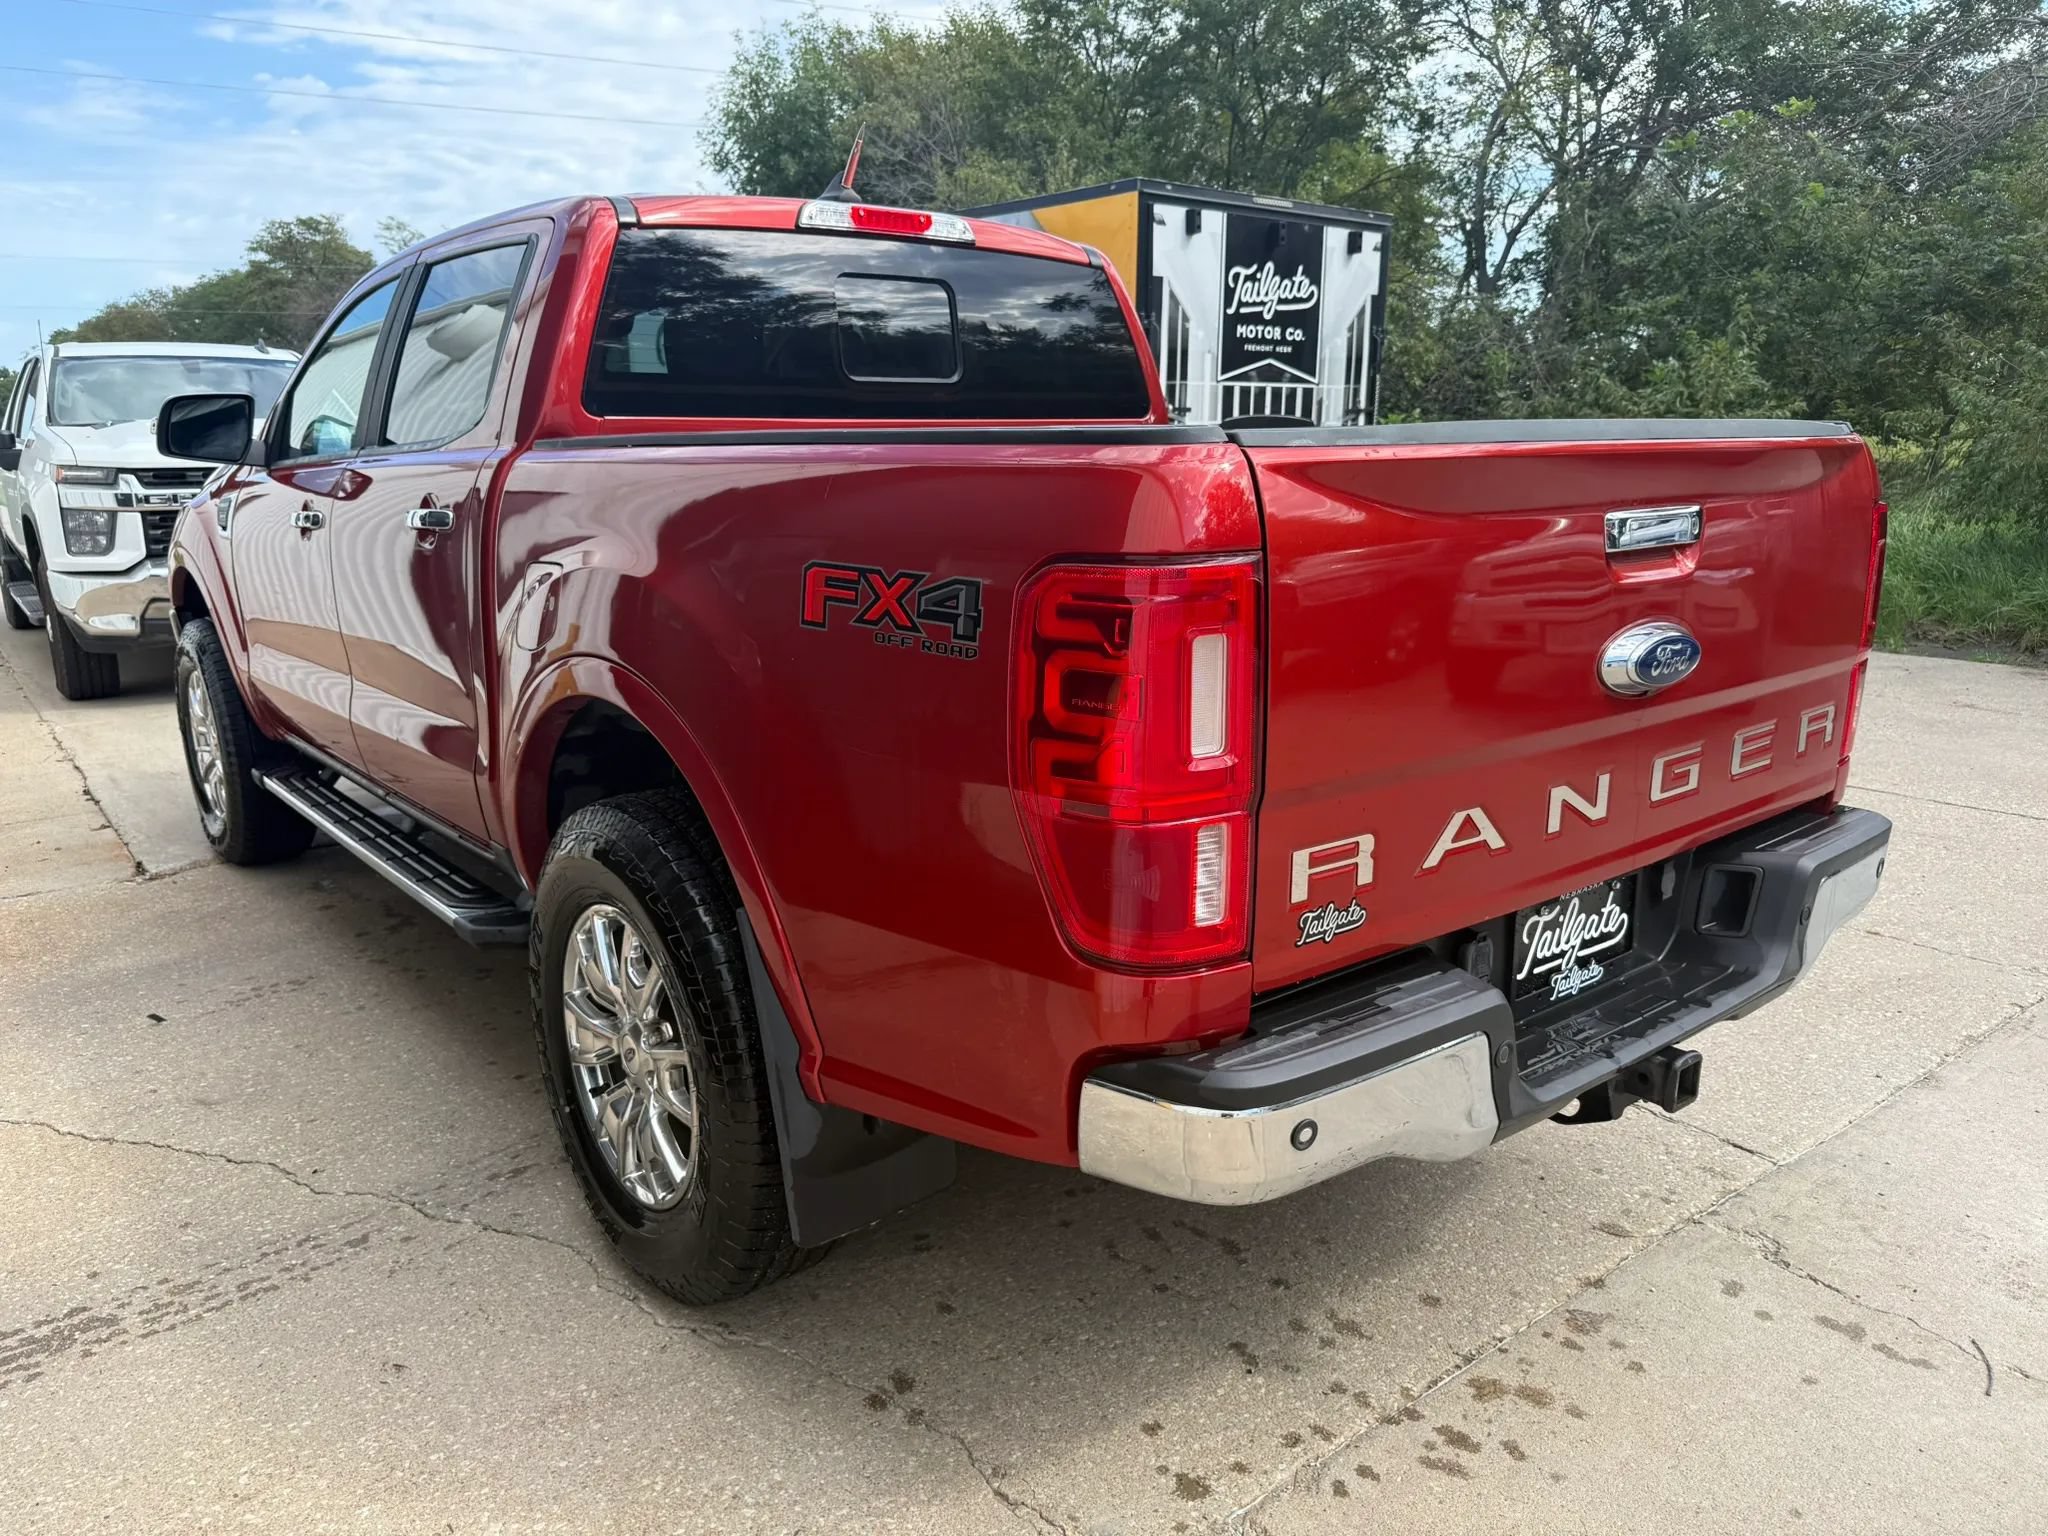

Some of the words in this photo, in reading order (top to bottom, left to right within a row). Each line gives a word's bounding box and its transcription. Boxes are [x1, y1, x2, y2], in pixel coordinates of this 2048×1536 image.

[1226, 261, 1318, 320] Tailgate
[1236, 324, 1281, 340] MOTOR
[800, 560, 983, 645] FX4
[874, 631, 913, 649] OFF
[920, 638, 979, 660] ROAD
[1651, 643, 1691, 676] Ford
[1290, 704, 1835, 904] RANGER
[1295, 898, 1367, 946] Tailgate
[1517, 890, 1628, 980] Tailgate
[1550, 958, 1604, 1001] Tailgate
